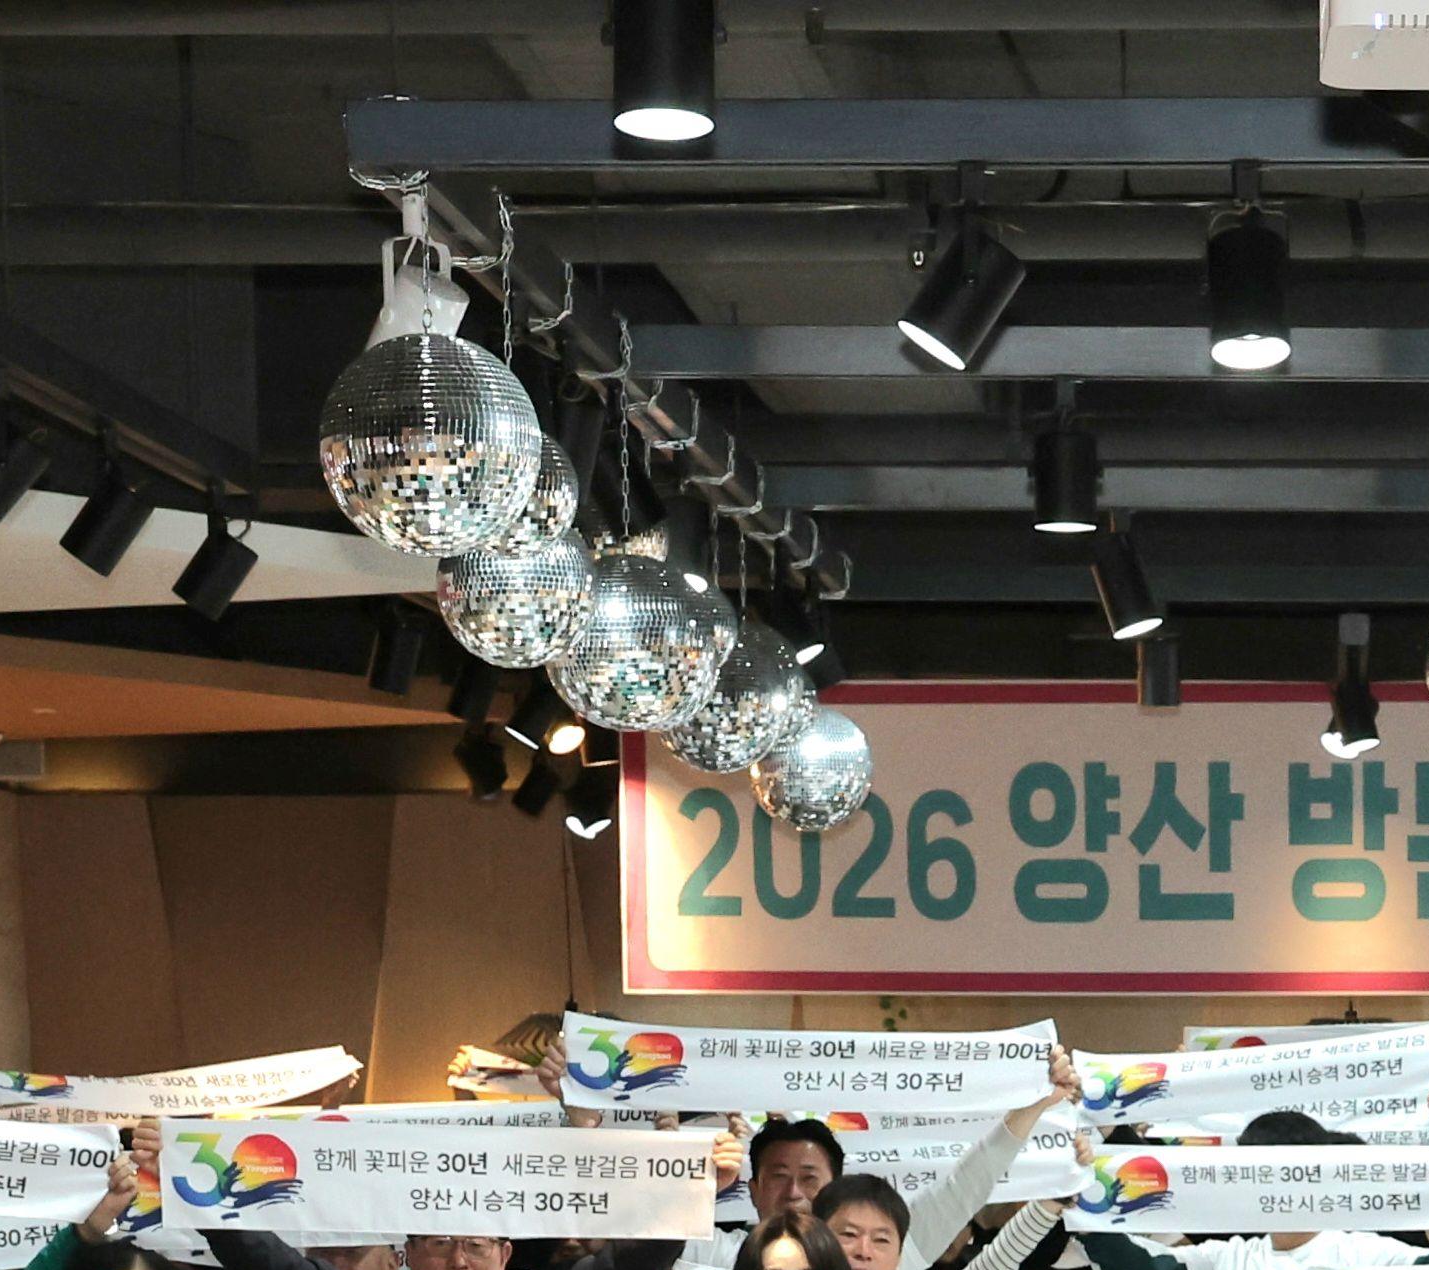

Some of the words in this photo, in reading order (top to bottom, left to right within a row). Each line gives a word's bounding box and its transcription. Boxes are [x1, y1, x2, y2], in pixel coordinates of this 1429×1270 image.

[678, 787, 976, 920] 2026
[1008, 758, 1243, 923] 양산
[700, 1038, 737, 1058] 함께
[745, 1039, 803, 1058] 꽃피운
[810, 1040, 855, 1059] 30년
[869, 1041, 926, 1059] 새로운
[934, 1042, 990, 1060] 발걸음
[314, 1148, 356, 1172] 함께
[365, 1150, 429, 1173] 꽃피운
[437, 1152, 487, 1175] 30년
[503, 1154, 567, 1177] 새로운
[575, 1155, 638, 1178] 발걸음
[647, 1157, 706, 1179] 100년
[1181, 1165, 1216, 1184] 함께
[1221, 1165, 1275, 1184] 꽃피운
[1280, 1165, 1321, 1183] 30년
